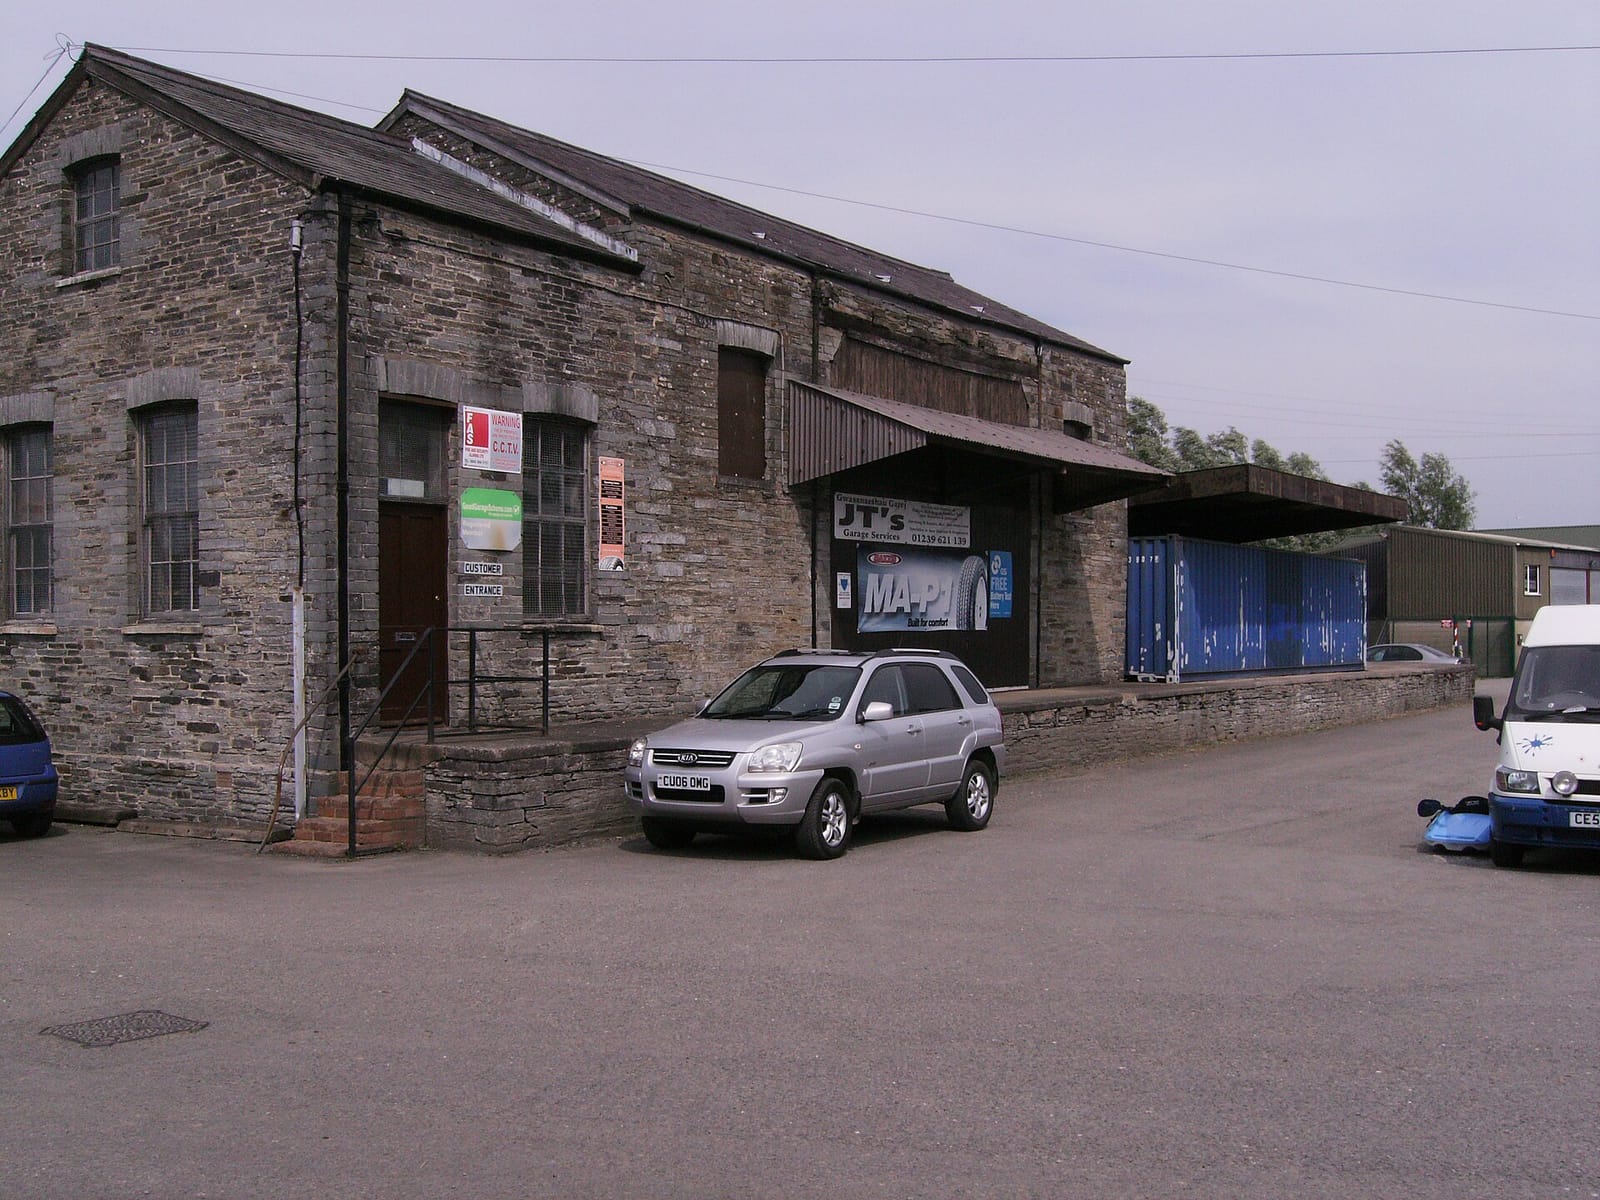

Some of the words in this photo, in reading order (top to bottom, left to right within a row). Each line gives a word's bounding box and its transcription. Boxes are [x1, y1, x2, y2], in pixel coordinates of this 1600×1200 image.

[492, 414, 520, 429] WARNING
[493, 441, 519, 455] C.C.T.V.
[838, 503, 905, 531] JT's
[843, 528, 869, 539] Garage
[871, 531, 901, 541] Services
[911, 534, 936, 544] 01239
[937, 535, 952, 545] 621
[953, 536, 967, 546] 139
[465, 563, 501, 574] CUSTOMER
[465, 585, 501, 595] ENTRANCE
[991, 576, 1008, 591] FREE
[907, 618, 920, 628] Built
[920, 618, 928, 628] for
[928, 618, 949, 628] comfort
[663, 775, 688, 787] CU06
[690, 776, 709, 789] OMG
